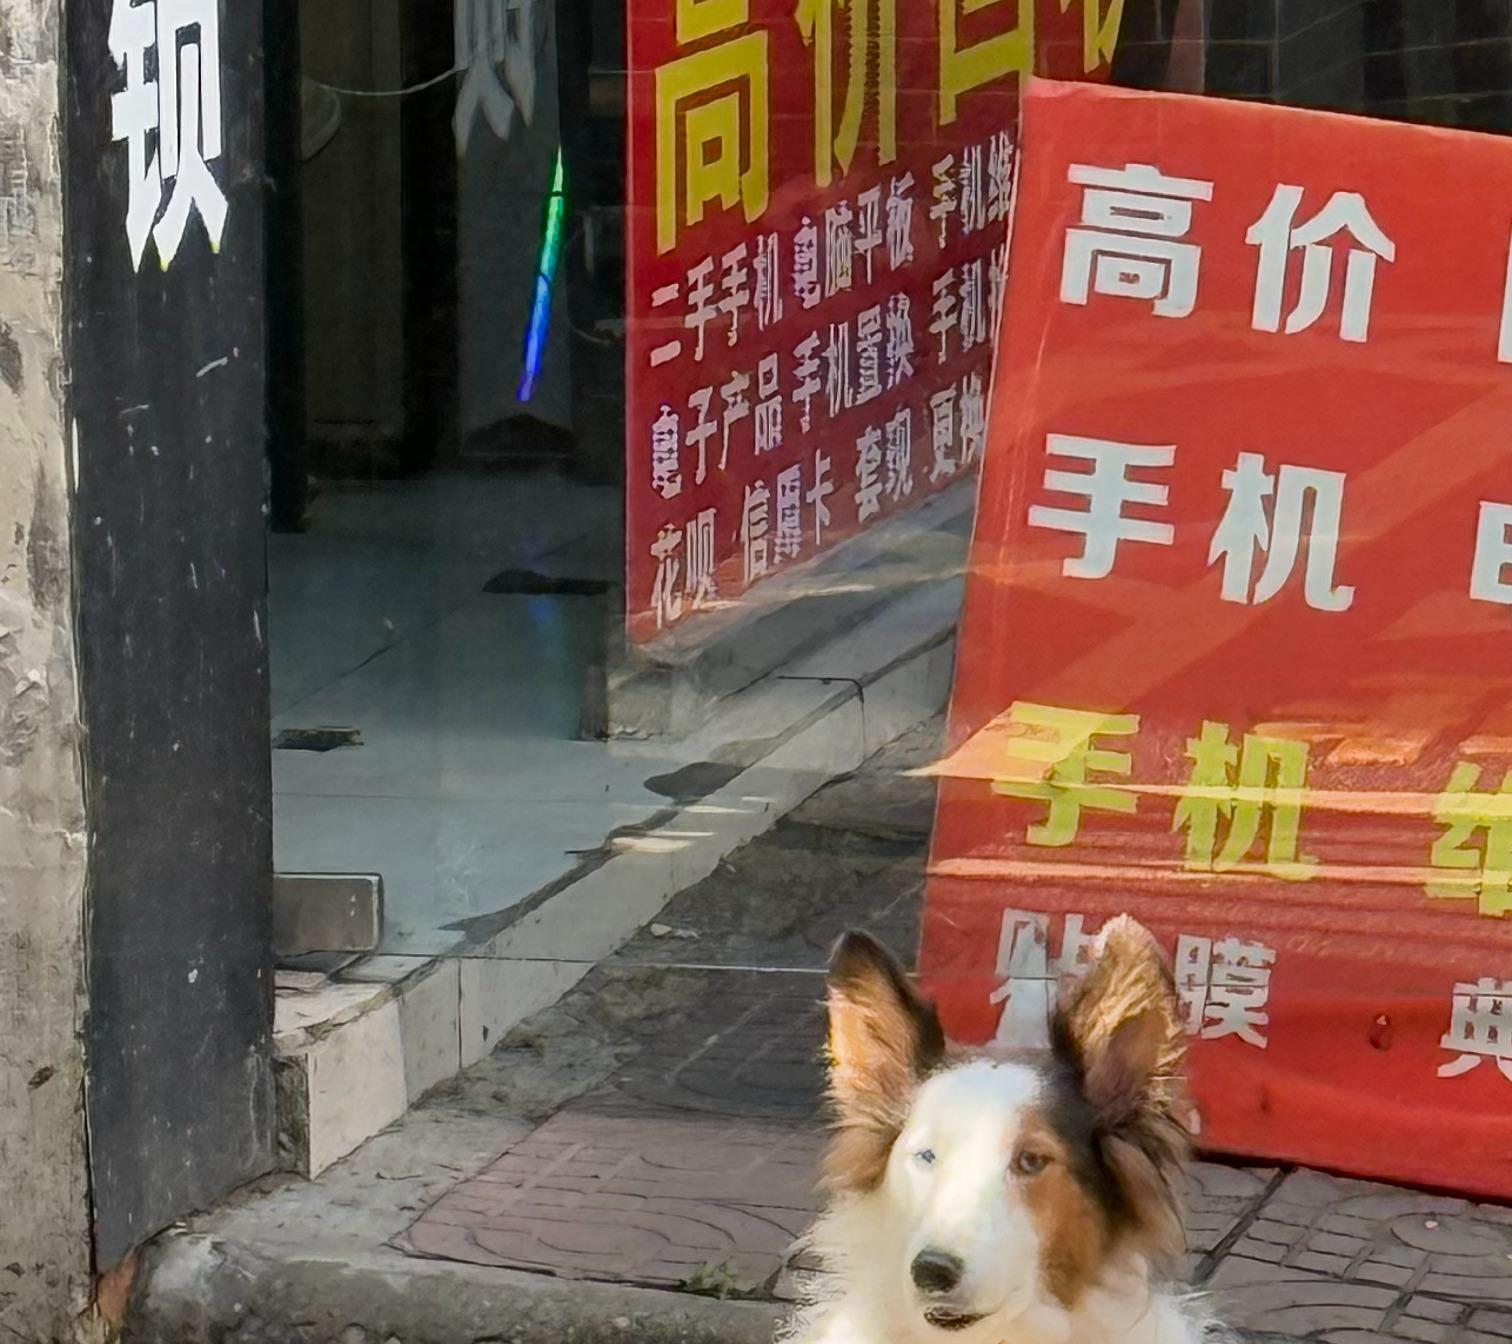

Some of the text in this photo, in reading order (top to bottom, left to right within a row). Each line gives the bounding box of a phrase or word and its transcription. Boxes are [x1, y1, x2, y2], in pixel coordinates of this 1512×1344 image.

[650, 231, 783, 367] 二手手机
[1057, 162, 1395, 344] 高价
[1026, 433, 1358, 615] 手机
[989, 701, 1318, 884] 手机
